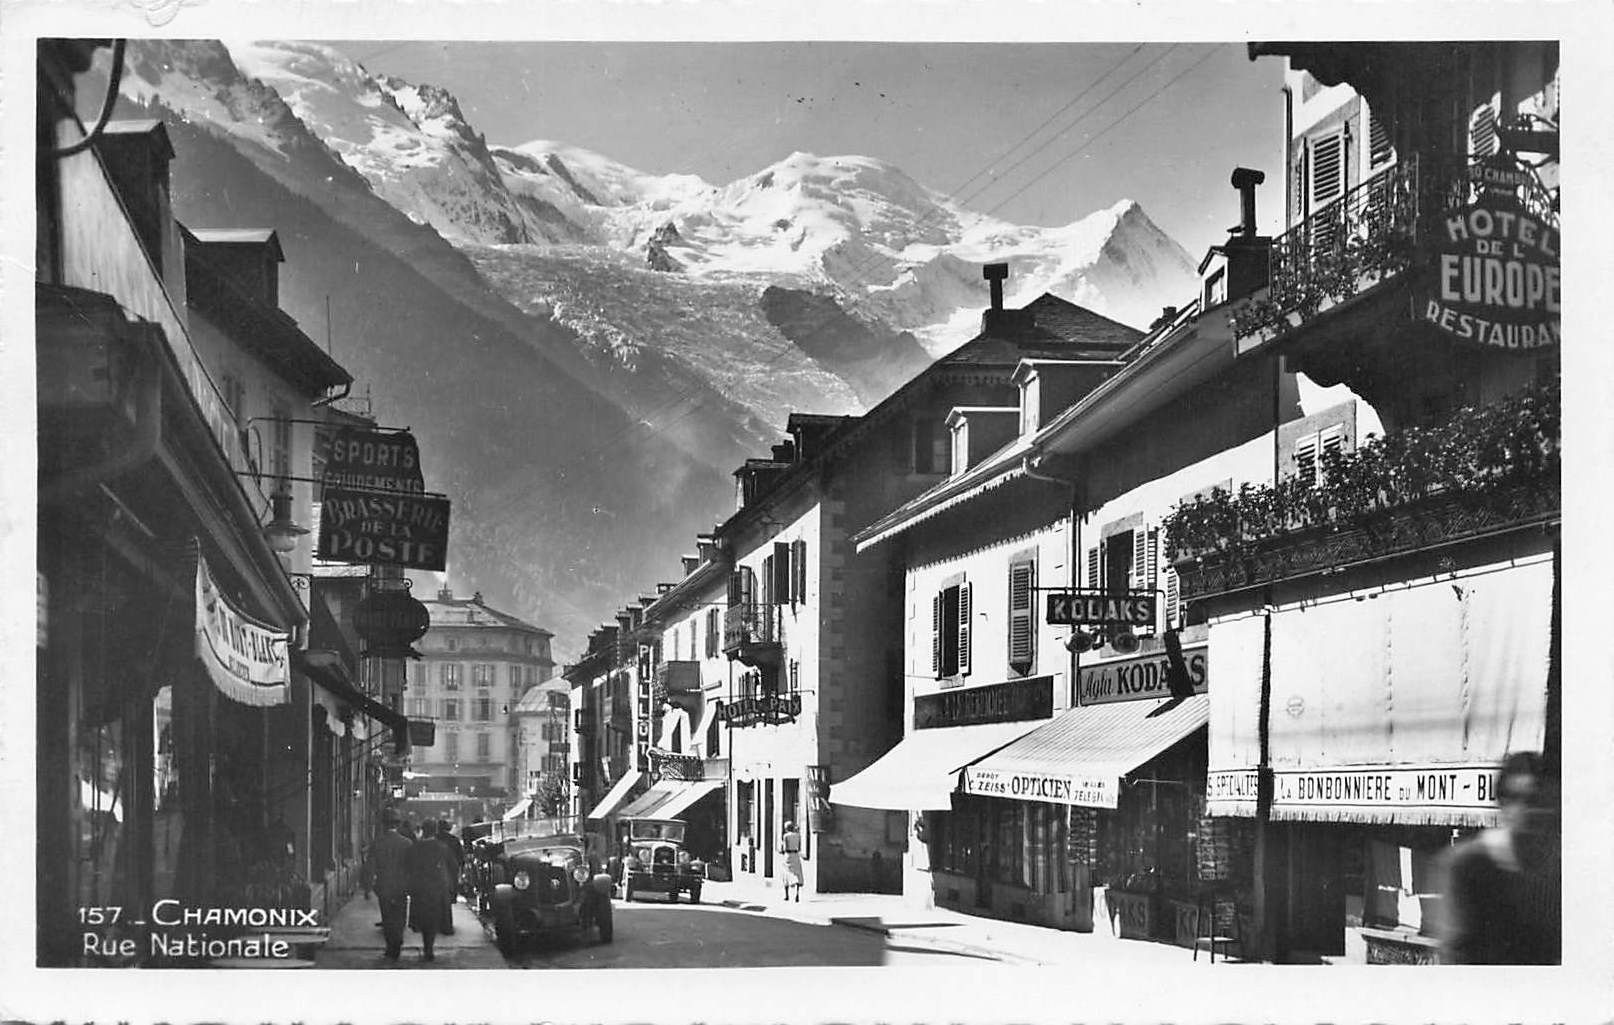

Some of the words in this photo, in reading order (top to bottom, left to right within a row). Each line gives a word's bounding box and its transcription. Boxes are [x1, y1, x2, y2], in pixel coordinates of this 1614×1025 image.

[1447, 208, 1555, 255] HOTEL
[1476, 239, 1504, 255] DE
[1441, 254, 1559, 312] EUROPE
[331, 530, 434, 562] POSTE
[1055, 600, 1149, 620] KODAKS
[1117, 654, 1205, 694] KODAS
[1012, 776, 1071, 799] OPTICIEN
[1298, 776, 1392, 800] BONBONNIERE
